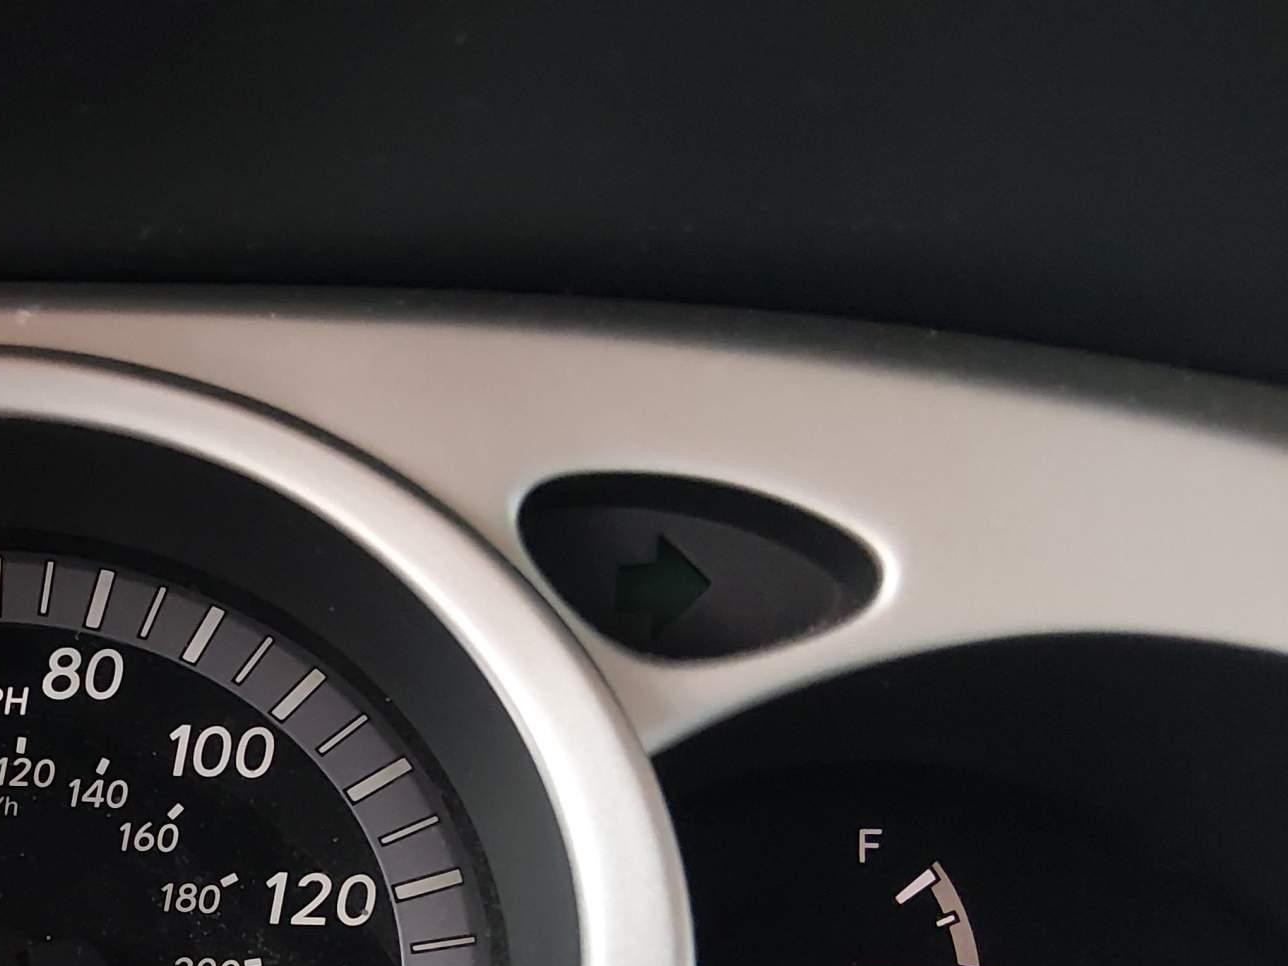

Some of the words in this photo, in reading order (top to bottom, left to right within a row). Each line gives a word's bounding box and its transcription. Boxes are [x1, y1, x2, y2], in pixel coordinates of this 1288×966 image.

[42, 648, 123, 699] 80
[170, 725, 274, 778] 100
[70, 779, 128, 808] 140
[120, 822, 178, 852] 160
[860, 829, 882, 863] F
[162, 883, 220, 913] 180
[266, 872, 376, 926] 120
